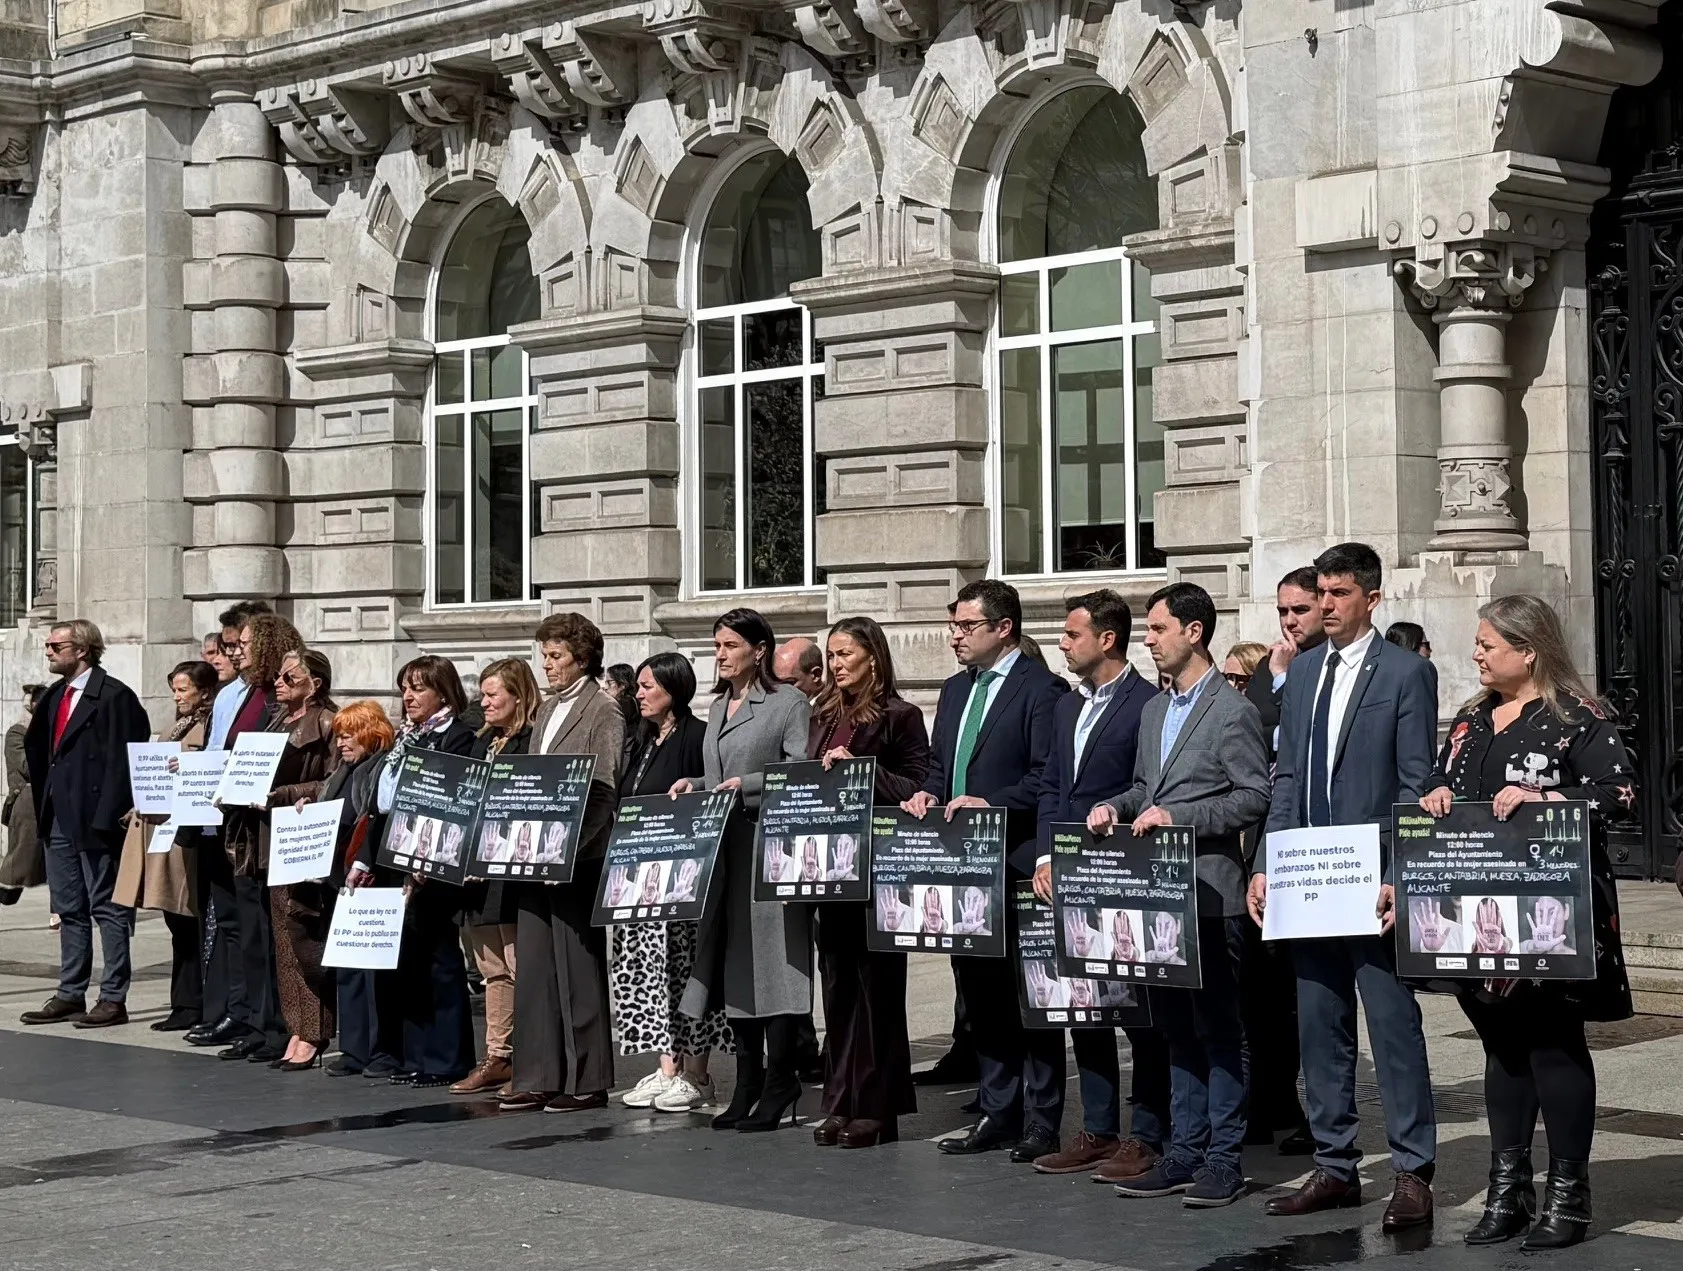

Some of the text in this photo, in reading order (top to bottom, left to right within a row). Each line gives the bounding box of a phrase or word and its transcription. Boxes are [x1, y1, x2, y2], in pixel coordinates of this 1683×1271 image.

[278, 845, 303, 855] dignidad
[978, 843, 988, 854] 14
[1285, 848, 1307, 858] sobre
[1309, 846, 1355, 856] nuestros
[1549, 845, 1564, 857] 14
[1106, 850, 1125, 858] silencio
[1458, 850, 1504, 859] Ayuntamiento
[284, 855, 311, 864] GOBIERNA
[1464, 861, 1482, 869] mujer
[1483, 860, 1516, 868] asesinada
[1539, 859, 1545, 869] 3
[1077, 866, 1089, 874] Plaza
[1098, 867, 1131, 875] Ayuntamiento
[1166, 865, 1179, 878] 14
[1274, 860, 1361, 874] embarazos NI sobre
[1102, 876, 1116, 884] mujer
[1402, 871, 1437, 881] BURGOS,
[1155, 879, 1161, 887] 3
[1270, 874, 1372, 890] nuestras vidas decide el
[376, 908, 384, 916] ley
